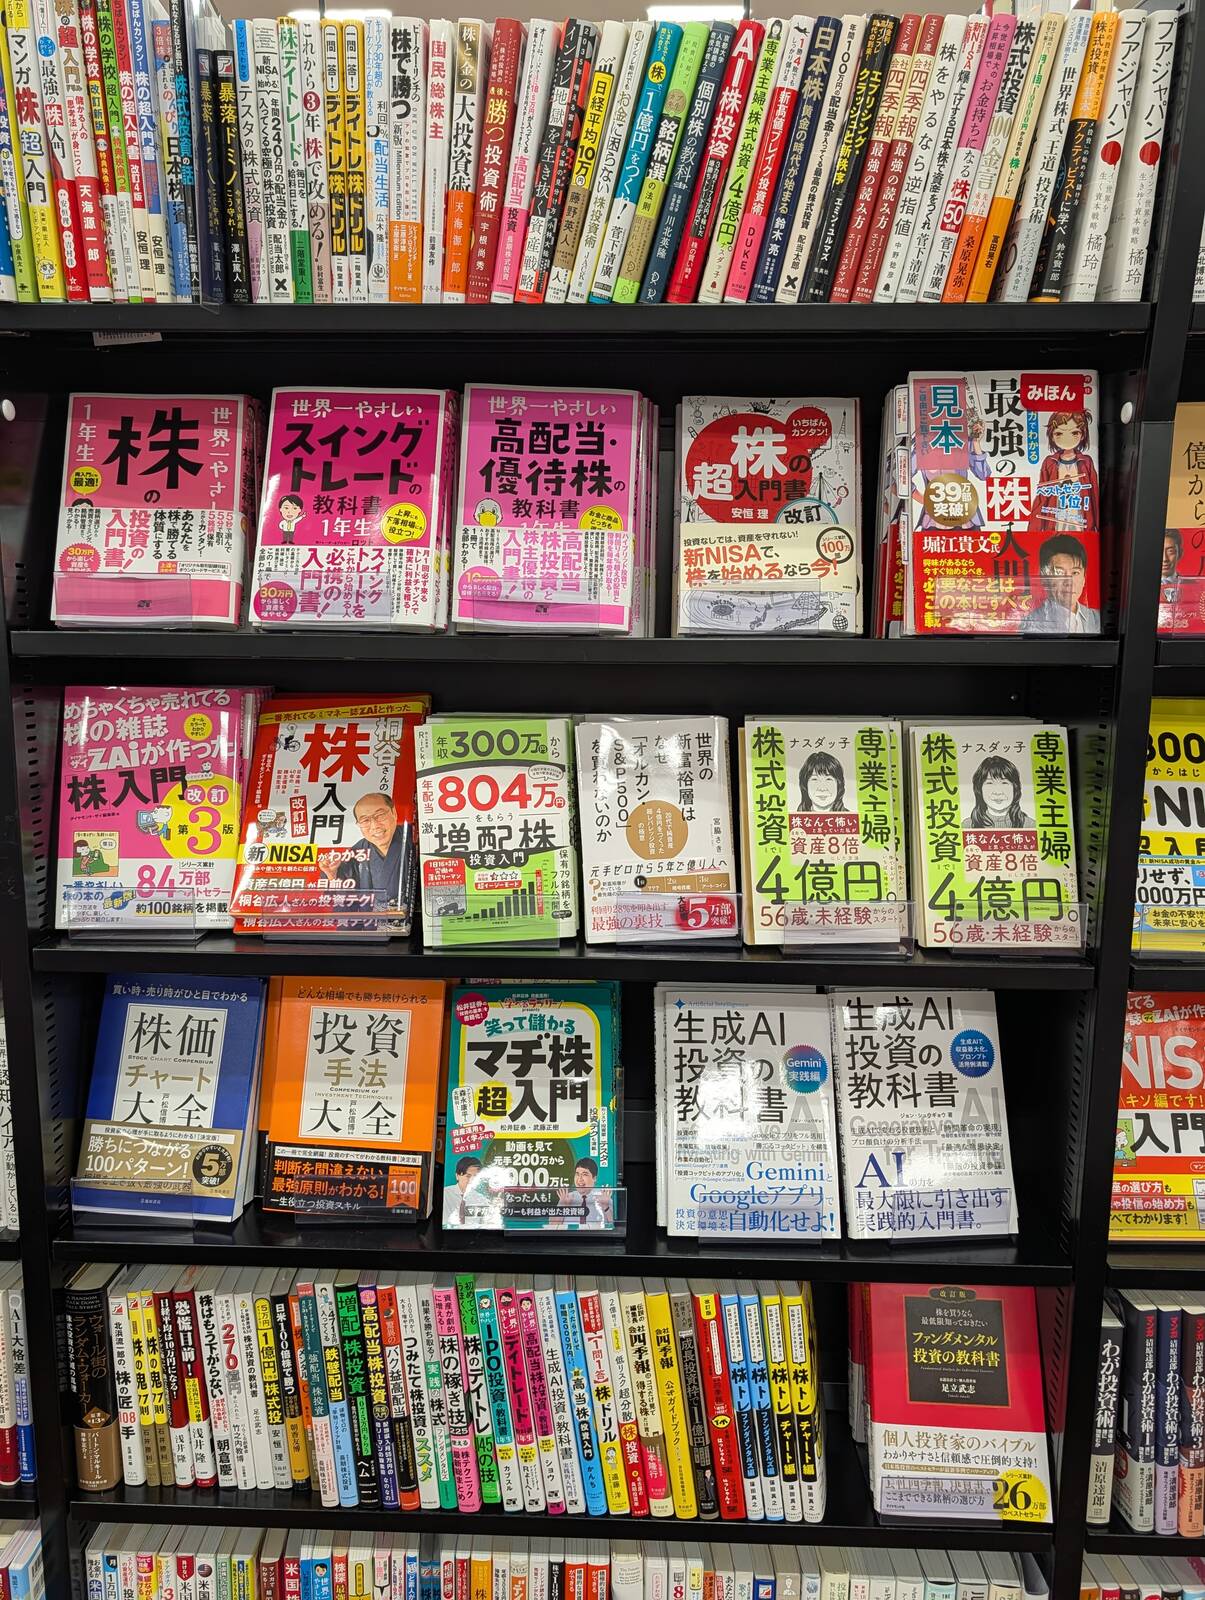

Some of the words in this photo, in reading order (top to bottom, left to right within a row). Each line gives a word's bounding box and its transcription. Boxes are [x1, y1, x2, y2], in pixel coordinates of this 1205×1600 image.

[391, 28, 412, 120] 株で勝つ
[460, 26, 477, 90] 株と金の
[802, 26, 837, 100] 日本株
[993, 21, 1037, 115] 株式投資
[429, 40, 447, 140] 国民総株主
[1106, 18, 1147, 140] プアジャパン
[1144, 18, 1179, 140] プアジャパン
[219, 82, 238, 186] 暴落ドミノ
[673, 80, 716, 190] 個別株の教科書
[894, 43, 958, 237] 株をやるなら逆指値
[239, 85, 262, 223] テスタの株式投資
[480, 98, 508, 213] 勝つ投資術
[752, 90, 791, 216] 新高値ブレイク投資術
[374, 139, 390, 209] 配当生活
[79, 184, 99, 261] 天海源一郎
[291, 398, 423, 418] 世界一やさしい
[488, 397, 617, 416] 世界一やさしい
[1027, 385, 1077, 402] みほん
[77, 403, 96, 463] 1年生
[791, 427, 829, 437] カンタン!
[792, 419, 828, 428] いちばん
[929, 385, 963, 454] 見本
[984, 378, 1025, 476] 最強の
[101, 407, 204, 490] 株
[281, 420, 430, 458] スイング
[290, 457, 422, 495] トレードの
[479, 456, 626, 497] 優待株の
[1036, 483, 1092, 496] ベストセラー
[312, 495, 382, 516] 教科書
[512, 499, 580, 519] 教科書
[784, 504, 823, 525] 改訂
[933, 502, 969, 517] 突破!
[987, 478, 1032, 520] 株
[1059, 494, 1090, 511] 1位!
[103, 509, 132, 574] 入門書!
[128, 509, 151, 560] 投資の
[167, 509, 182, 560] 株で勝てる
[180, 509, 194, 551] あなたを
[321, 518, 370, 537] 1年生
[683, 530, 800, 546] 投資なしでは、資産を守れない!
[540, 530, 561, 600] 株投資と
[561, 531, 582, 592] 高配当
[922, 558, 976, 567] 興味があるなら
[411, 548, 421, 615] トレードチャンスで
[64, 688, 231, 720] めちゃくちゃ売れてる
[64, 714, 168, 746] 株の雑誌
[436, 736, 448, 760] 年収
[550, 736, 561, 759] から
[790, 737, 851, 750] ナスダッ子
[962, 741, 1027, 753] ナスダッ子
[299, 723, 371, 783] 株
[695, 732, 715, 781] 世界の
[422, 780, 434, 815] 年配当
[752, 726, 788, 847] 株式投資
[856, 727, 891, 852] 専業主婦、
[921, 733, 962, 864] 株式投資
[1034, 732, 1071, 869] 専業主婦、
[290, 796, 309, 837] 改訂版
[310, 783, 347, 845] 入門
[475, 813, 514, 823] をもらう
[791, 816, 858, 828] 株なんて怖い
[790, 835, 860, 857] 資産8倍
[965, 832, 1037, 845] 株なんて怖い
[468, 851, 526, 867] 投資入門
[590, 858, 729, 878] 元手ゼロから5年で億り人へ
[965, 852, 1039, 873] 資産8倍
[179, 870, 210, 887] 万部
[755, 855, 897, 907] 4億円。
[135, 900, 229, 916] 約100銘柄を掲載
[928, 872, 1080, 923] 4億円。
[591, 915, 664, 932] 最強の裏技
[759, 905, 873, 928] 56歳・未経験
[933, 922, 1053, 944] 56歳・未経験
[112, 984, 249, 1003] 買い時・売り時がひと目でわかる
[296, 988, 429, 1005] どんな相場でも勝ち続けられる
[484, 1013, 577, 1038] 笑って儲かる
[673, 1010, 787, 1047] 生成AI
[843, 996, 955, 1032] 生成AI
[128, 1011, 220, 1058] 株価
[312, 1011, 406, 1059] 投資
[845, 1033, 943, 1072] 投資の
[323, 1057, 389, 1089] 手法
[466, 1031, 594, 1079] マヂ株
[786, 1058, 823, 1069] Gemini
[124, 1064, 212, 1093] チャート
[848, 1071, 960, 1109] 教科書
[307, 1099, 398, 1137] 大全
[476, 1079, 589, 1124] 超入門
[87, 1135, 193, 1158] 勝ちにつながる
[494, 1153, 566, 1168] 元手200万から
[504, 1142, 553, 1153] 動画を見て
[85, 1153, 189, 1179] 100パターン!
[273, 1160, 384, 1180] 判断を間違えない
[270, 1197, 361, 1212] 一生役立つ投資スキル
[271, 1178, 385, 1200] 最強原則がわかる!
[390, 1179, 418, 1196] 100
[856, 1188, 1009, 1210] 最大限に引き出す
[676, 1208, 728, 1220] 投資の意思
[728, 1210, 836, 1233] 自動化せよ!
[921, 1317, 989, 1327] 最低限知っておきたい
[935, 1308, 974, 1317] 株を買うなら
[174, 1301, 196, 1377] 恐慌目前!
[199, 1295, 224, 1399] 株はもう下がらない
[361, 1306, 387, 1405] 高配当株投資
[912, 1331, 999, 1347] ファンダメンタル
[913, 1347, 1001, 1367] 投資の教科書
[325, 1348, 344, 1401] 鉄壁配当
[440, 1336, 467, 1425] 株の稼ぎ技
[731, 1366, 750, 1411] 株トレ
[751, 1366, 770, 1411] 株トレ
[771, 1367, 790, 1412] 株トレ
[792, 1368, 811, 1413] 株トレ
[1095, 1339, 1121, 1429] わが投資術
[883, 1429, 1037, 1453] 個人投資家のバイブル
[883, 1450, 1039, 1469] わかりやすさと信頼感で圧倒的支持!
